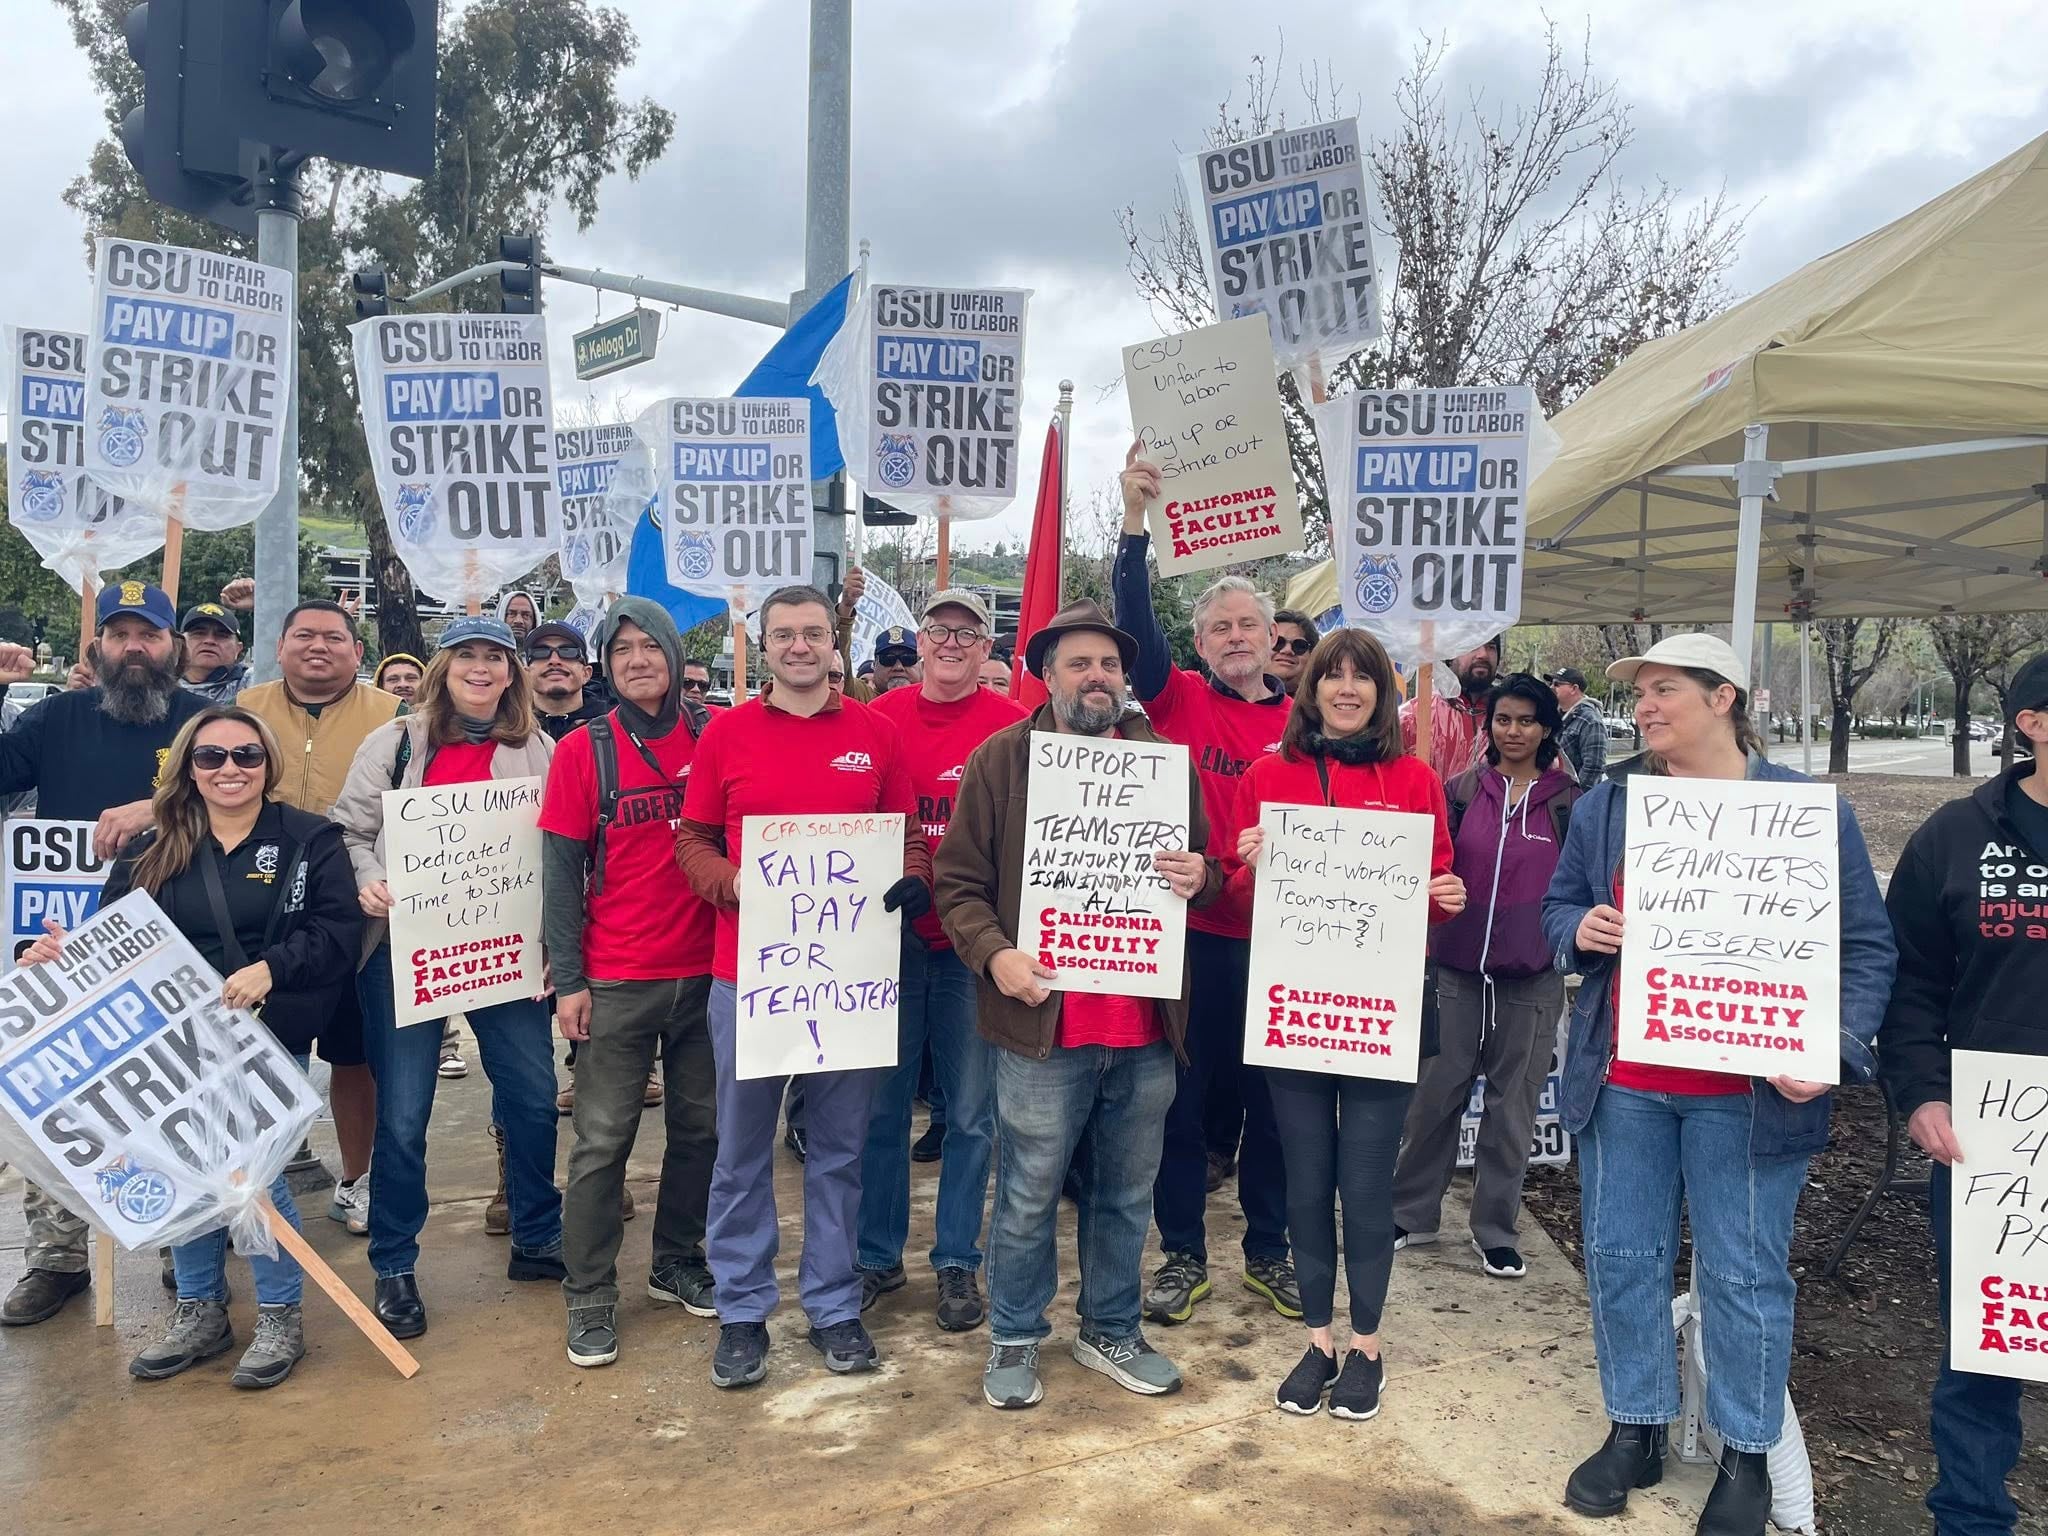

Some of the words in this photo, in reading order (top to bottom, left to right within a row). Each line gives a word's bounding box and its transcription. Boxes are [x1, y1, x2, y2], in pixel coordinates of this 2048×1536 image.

[1279, 128, 1336, 156] UNFAIR
[1205, 140, 1275, 195] CSU
[1282, 156, 1300, 177] TO
[1305, 145, 1355, 171] LABOR
[1219, 197, 1268, 240] PAY
[1276, 189, 1314, 227] UP
[1323, 187, 1360, 218] OR
[107, 244, 191, 294] CSU
[199, 257, 266, 289] UNFAIR
[1221, 222, 1368, 296] STRIKE
[198, 278, 218, 298] TO
[224, 288, 283, 312] LABOR
[877, 289, 944, 329] CSU
[951, 294, 1003, 312] UNFAIR
[1279, 275, 1371, 344] OUT
[111, 302, 171, 342] PAY
[181, 313, 228, 349] UP
[234, 330, 276, 366] OR
[459, 320, 521, 339] UNFAIR
[950, 313, 967, 330] TO
[971, 315, 1018, 332] LABOR
[379, 320, 452, 363] CSU
[460, 342, 481, 361] TO
[486, 342, 542, 361] LABOR
[589, 336, 624, 360] Kellogg
[625, 327, 637, 347] Dr
[1132, 339, 1182, 370] CSU
[883, 343, 935, 373] PAY
[940, 346, 975, 376] UP
[982, 355, 1014, 382] OR
[1215, 357, 1237, 373] to
[101, 348, 276, 419] STRIKE
[391, 379, 443, 415] PAY
[451, 378, 494, 413] UP
[503, 387, 542, 418] OR
[1444, 392, 1506, 412] UNFAIR
[673, 402, 736, 435] CSU
[742, 403, 791, 417] UNFAIR
[877, 382, 1014, 432] STRIKE
[1358, 393, 1436, 436] CSU
[1442, 415, 1462, 434] TO
[1468, 413, 1524, 433] LABOR
[555, 430, 593, 460] CSU
[596, 427, 632, 440] UNFAIR
[742, 420, 759, 434] TO
[762, 419, 805, 434] LABOR
[1139, 426, 1177, 459] Pay
[158, 411, 273, 481] OUT
[390, 424, 548, 476] STRIKE
[597, 443, 608, 454] TO
[679, 449, 727, 476] PAY
[733, 449, 766, 476] UP
[773, 455, 803, 479] OR
[925, 435, 1014, 489] OUT
[561, 466, 590, 492] PAY
[1364, 452, 1423, 486] PAY
[1428, 451, 1472, 486] UP
[1480, 459, 1518, 489] OR
[448, 481, 550, 540] OUT
[674, 484, 805, 525] STRIKE
[1170, 503, 1276, 540] FACULTY
[1356, 497, 1518, 546] STRIKE
[724, 530, 806, 577] OUT
[1412, 553, 1516, 611] OUT
[845, 752, 871, 765] CFA
[1038, 743, 1166, 780] SUPPORT
[401, 792, 474, 822] CSU
[484, 788, 541, 812] UNFAIR
[1079, 781, 1144, 807] THE
[426, 823, 466, 845] TO
[762, 821, 800, 842] CFA
[807, 816, 901, 839] SOLIDARITY
[1034, 814, 1186, 851] TEAMSTERS
[1271, 809, 1346, 844] Treat
[1361, 831, 1408, 848] our
[1643, 795, 1723, 840] PAY
[1737, 801, 1832, 838] THE
[13, 826, 103, 872] CSU
[405, 836, 512, 873] Dedicated
[1028, 848, 1056, 867] AN
[1057, 851, 1130, 869] INJURY
[1628, 842, 1829, 890] TEAMSTERS
[758, 850, 859, 887] FAIR
[1029, 870, 1051, 888] IS
[1053, 871, 1075, 889] AN
[1080, 874, 1141, 892] INJURY
[1148, 875, 1171, 890] TO
[1979, 864, 2016, 878] to
[401, 892, 449, 915] Time
[466, 885, 483, 901] to
[1081, 890, 1152, 914] ALL
[1271, 880, 1377, 917] Teamsters
[1638, 887, 1720, 913] WHAT
[1734, 892, 1831, 922] THEY
[1980, 881, 2007, 897] is
[22, 890, 89, 928] PAY
[791, 893, 868, 936] PAY
[55, 912, 131, 973] UNFAIR
[1040, 929, 1160, 954] FACULTY
[1649, 924, 1830, 961] DESERVE
[1979, 922, 2014, 937] to
[67, 964, 101, 994] TO
[97, 919, 171, 981] LABOR
[414, 950, 521, 987] FACULTY
[758, 943, 833, 972] FOR
[741, 978, 899, 1017] TEAMSTERS
[1648, 993, 1805, 1028] FACULTY
[6, 1030, 96, 1107] PAY
[99, 991, 146, 1052] UP
[150, 964, 212, 1015] OR
[1268, 1006, 1394, 1036] FACULTY
[807, 1020, 824, 1065] !
[2012, 1130, 2048, 1166] 4
